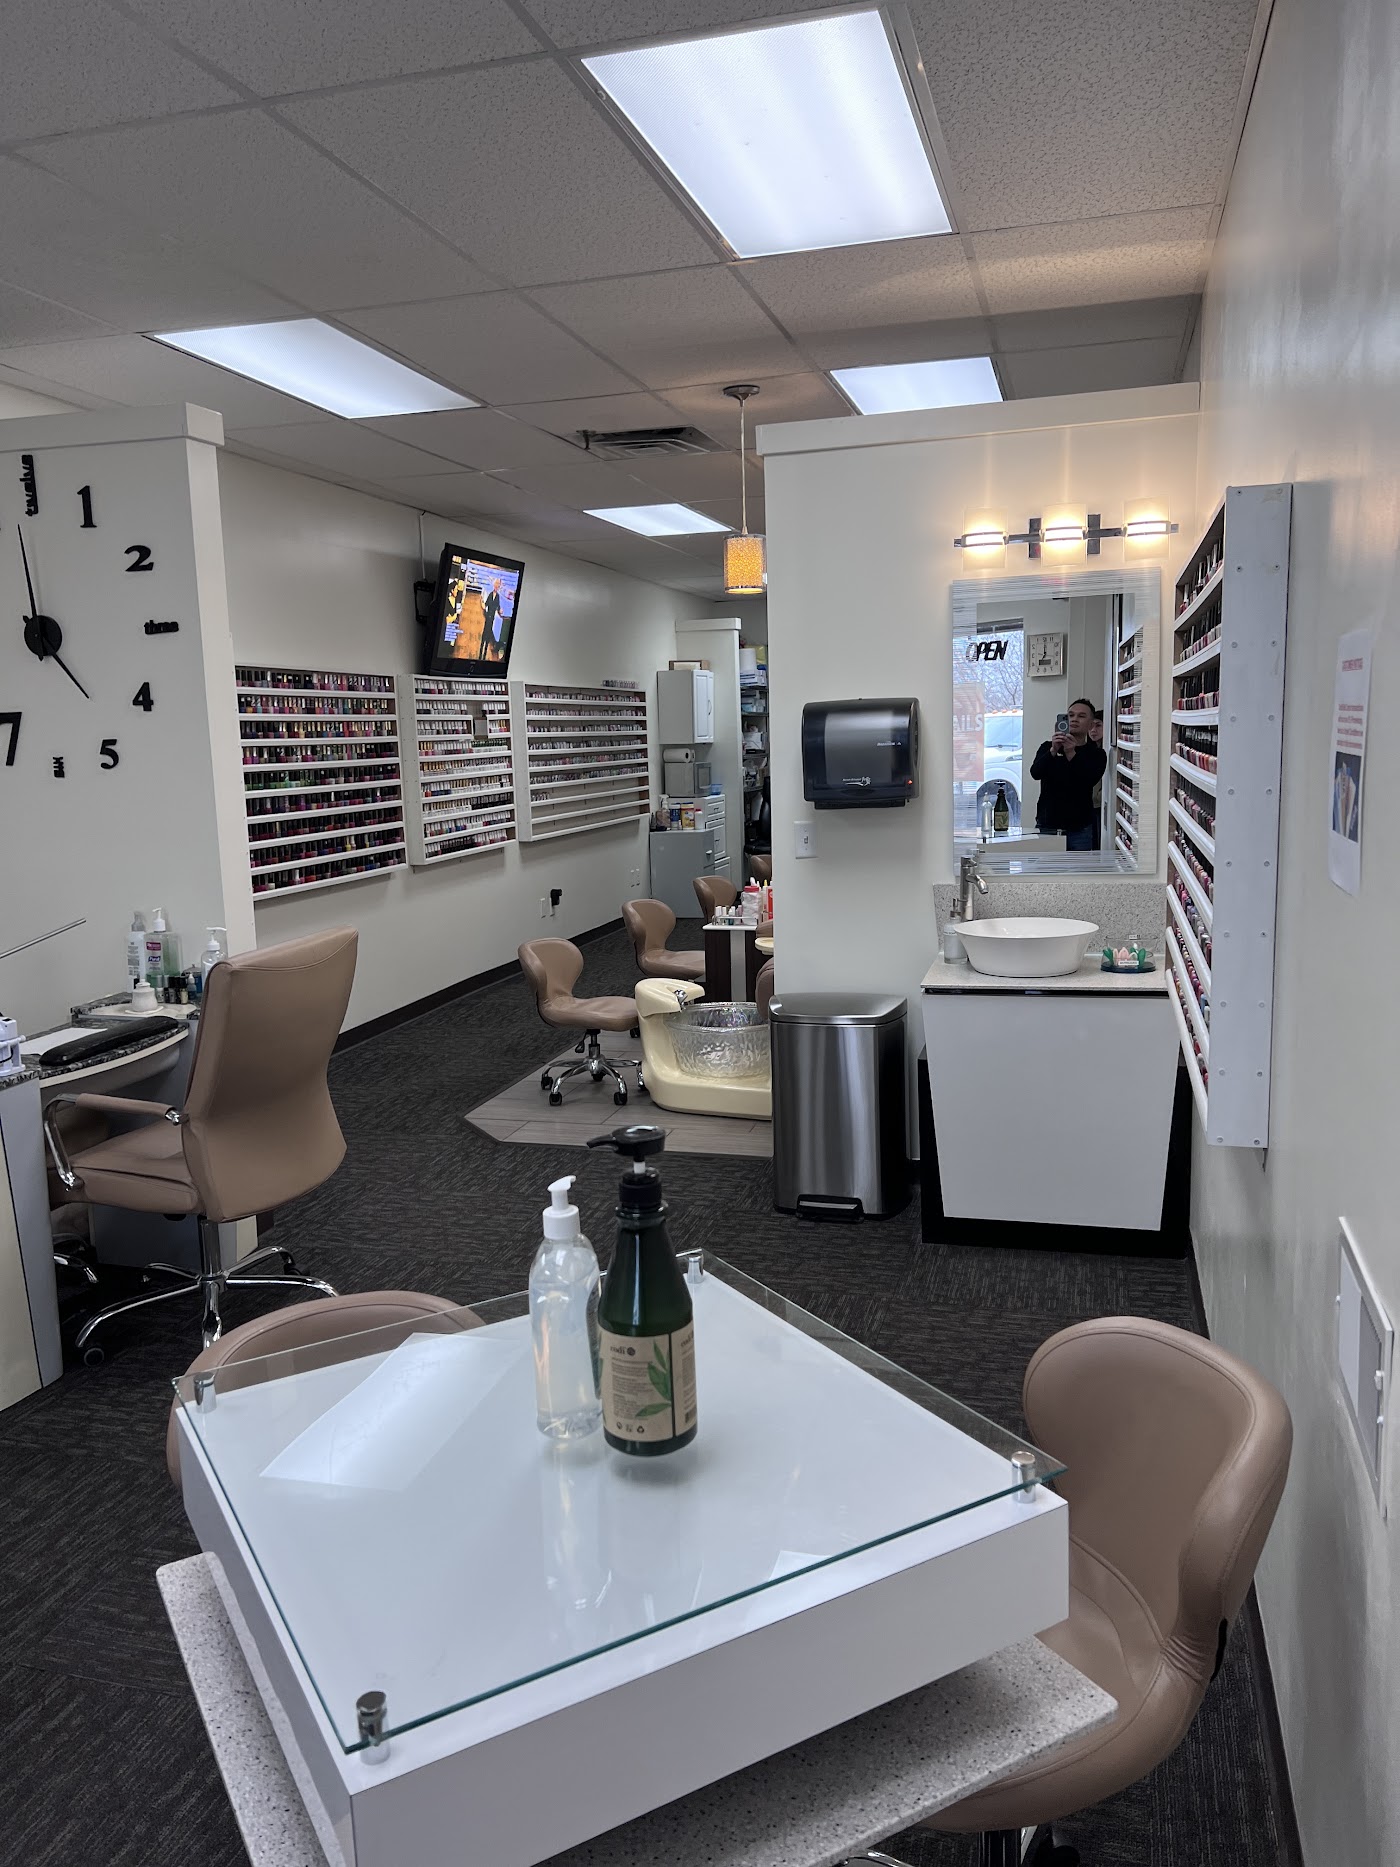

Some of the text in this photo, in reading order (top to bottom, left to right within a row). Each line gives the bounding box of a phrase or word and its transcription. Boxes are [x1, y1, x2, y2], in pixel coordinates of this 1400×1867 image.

[20, 454, 38, 517] twelve
[77, 485, 97, 528] 1
[124, 545, 155, 572] 2
[144, 619, 180, 635] three
[966, 640, 1008, 661] OPEN
[132, 682, 155, 712] 4
[0, 711, 22, 767] 7
[100, 738, 120, 769] 5
[52, 756, 65, 778] six
